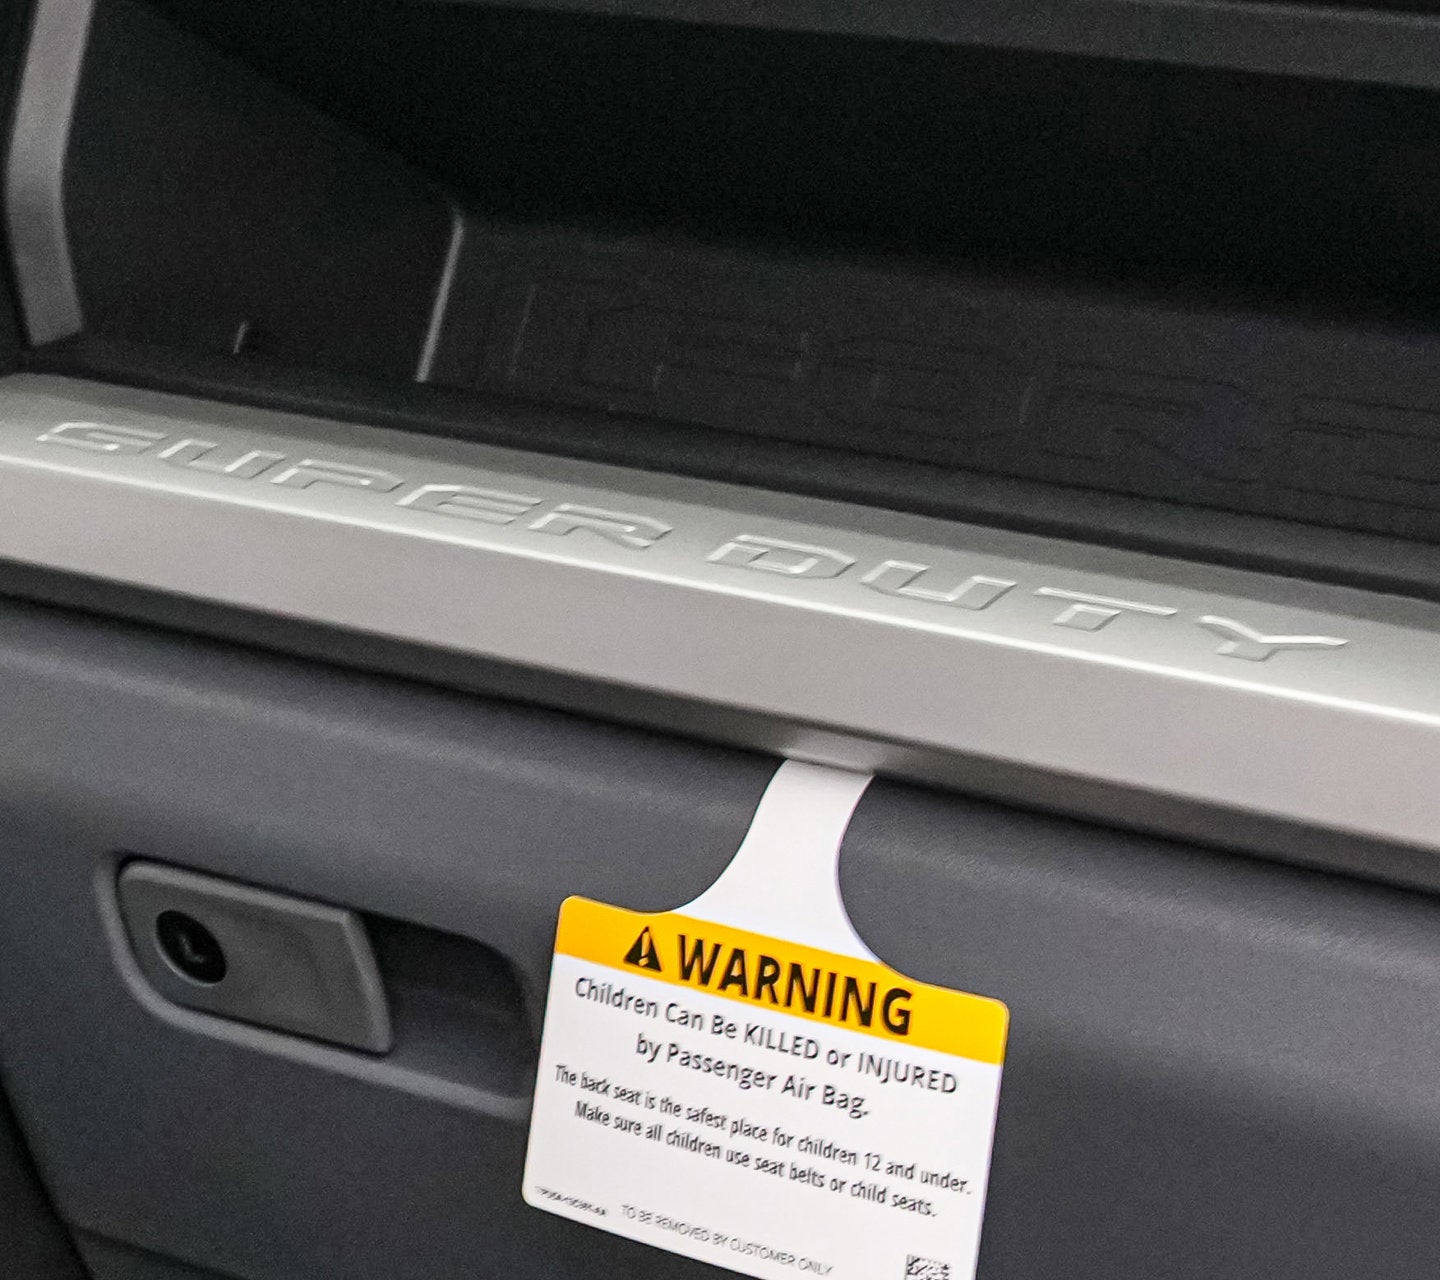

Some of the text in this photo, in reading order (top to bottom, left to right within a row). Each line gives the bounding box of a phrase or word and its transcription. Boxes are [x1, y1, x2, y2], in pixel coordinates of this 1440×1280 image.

[34, 419, 1351, 663] SUPER DUTY
[575, 977, 957, 1094] Children Can Be KILLED or INJURED
[679, 934, 912, 1036] WARNING
[555, 1064, 971, 1195] The back seat is the safest place for children 12 and under.
[636, 1033, 869, 1120] by Passenger Air Bag.
[574, 1100, 936, 1218] Make sure all children use seat belts or child seats.
[621, 1204, 833, 1276] TO BE REMOVED BY CUSTOMER ONLY
